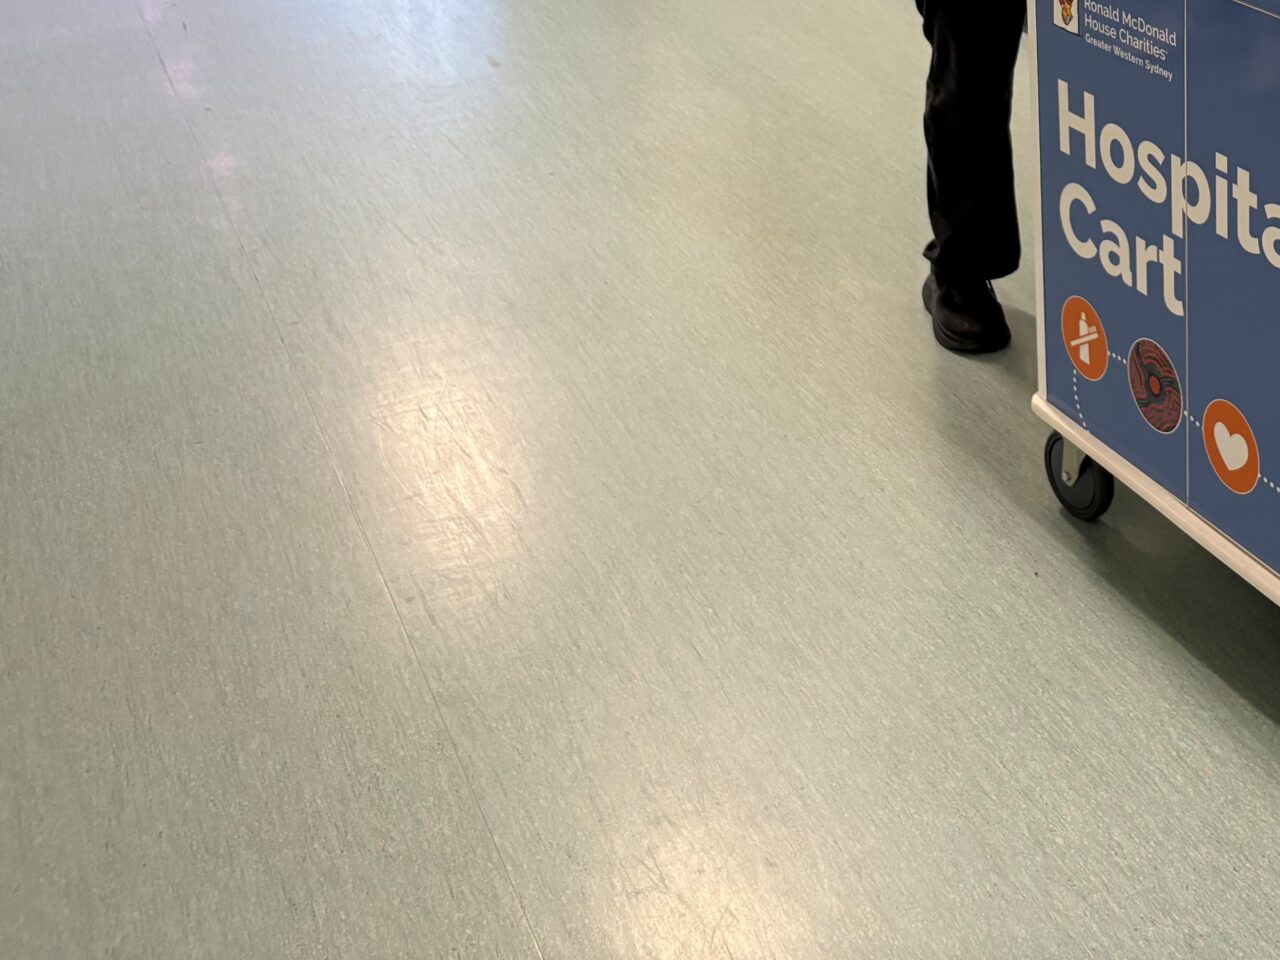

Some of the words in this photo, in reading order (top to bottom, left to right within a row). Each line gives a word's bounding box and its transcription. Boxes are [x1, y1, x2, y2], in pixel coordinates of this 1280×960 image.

[1084, 14, 1116, 38] House
[1119, 28, 1167, 60] Charities
[1122, 11, 1177, 47] McDonald
[1085, 33, 1111, 52] Greater
[1112, 44, 1143, 67] Western
[1145, 59, 1173, 82] Sydney
[1059, 182, 1185, 316] Cart
